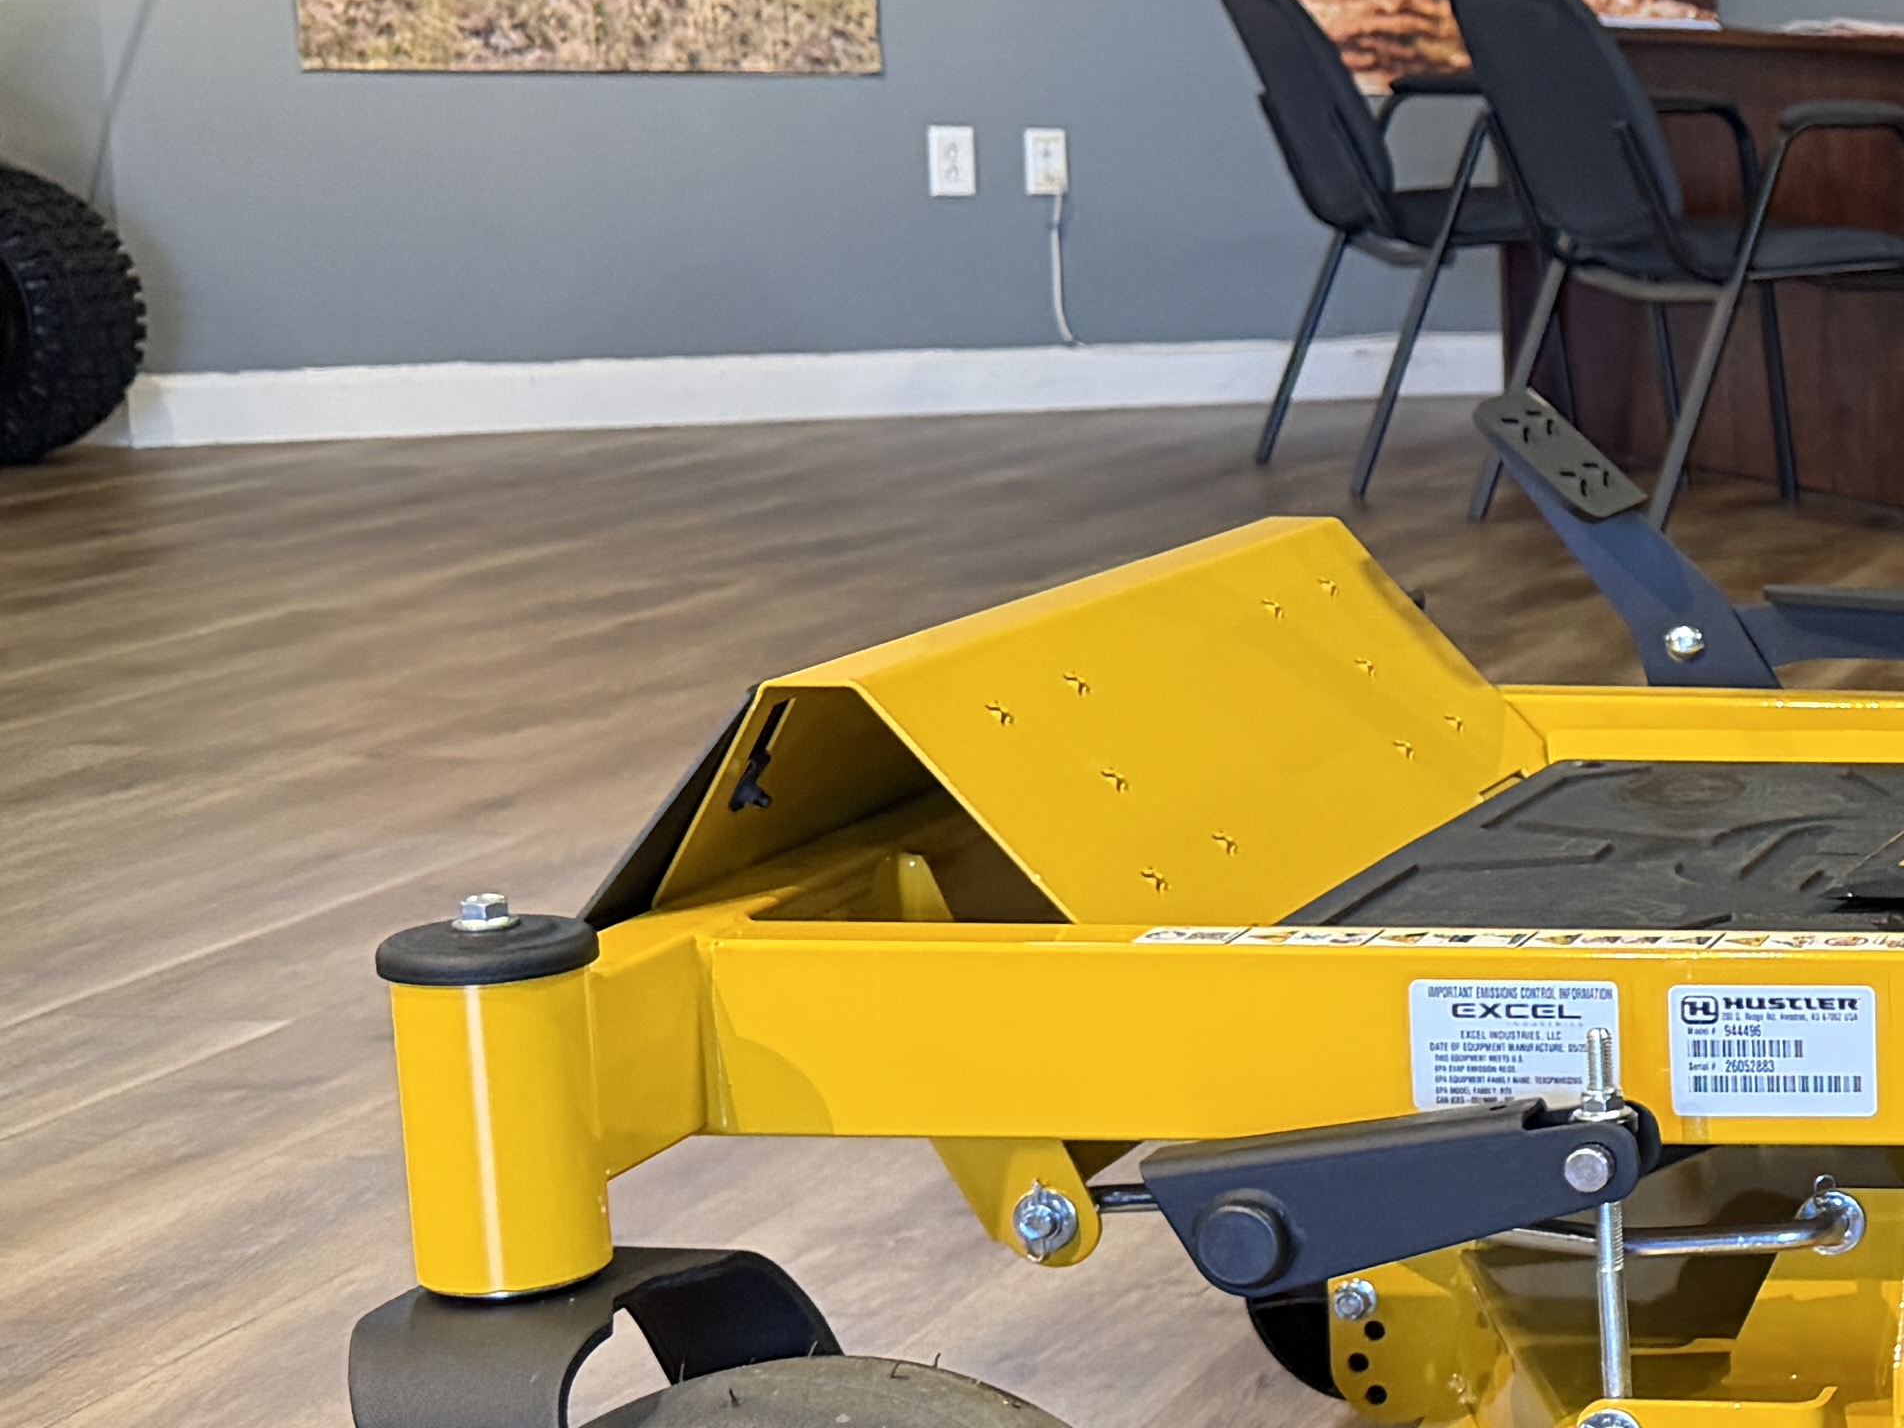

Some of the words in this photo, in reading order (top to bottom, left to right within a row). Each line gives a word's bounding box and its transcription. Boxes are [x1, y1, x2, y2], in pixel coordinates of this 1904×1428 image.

[1428, 986, 1473, 998] IMPORTANT
[1476, 987, 1517, 999] EMISSIONS
[1520, 987, 1555, 1000] CONTROL
[1559, 987, 1613, 1000] INFORMATION
[1723, 997, 1859, 1010] HUSTLER
[1451, 1003, 1582, 1019] EXCEL
[1460, 1030, 1486, 1040] EXCEL
[1547, 1031, 1561, 1040] LLC
[1724, 1024, 1761, 1037] 944496
[1429, 1042, 1449, 1051] DATE
[1451, 1042, 1460, 1051] OF
[1463, 1042, 1505, 1052] EQUIPMENT
[1725, 1060, 1775, 1073] 26052883
